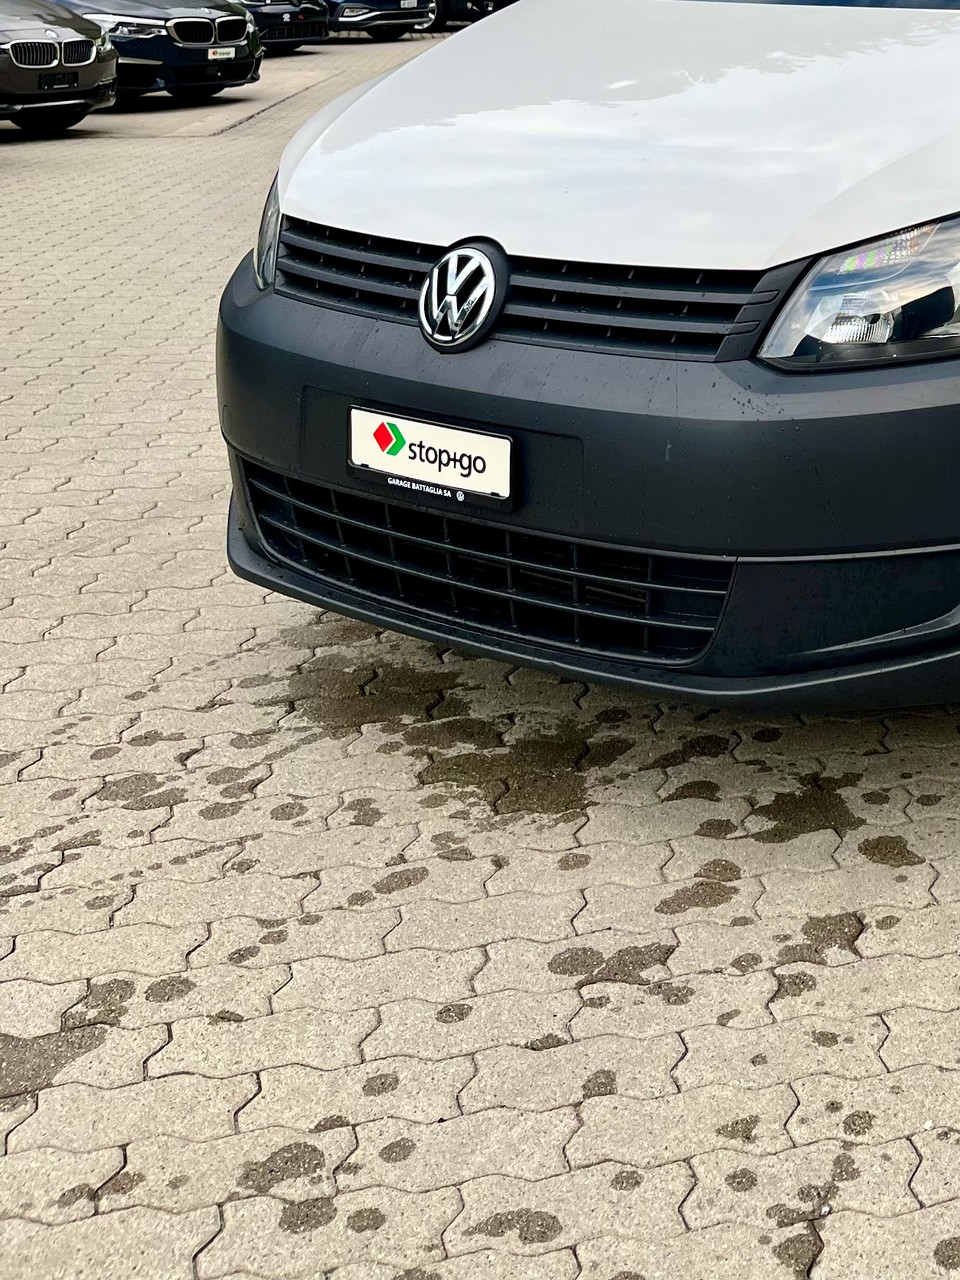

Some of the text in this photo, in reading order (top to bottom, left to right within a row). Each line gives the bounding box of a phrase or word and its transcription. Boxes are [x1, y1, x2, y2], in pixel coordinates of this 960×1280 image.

[424, 250, 494, 339] VW
[408, 440, 487, 478] stop+go
[387, 477, 451, 498] GARAGE BATTAGLIA SA
